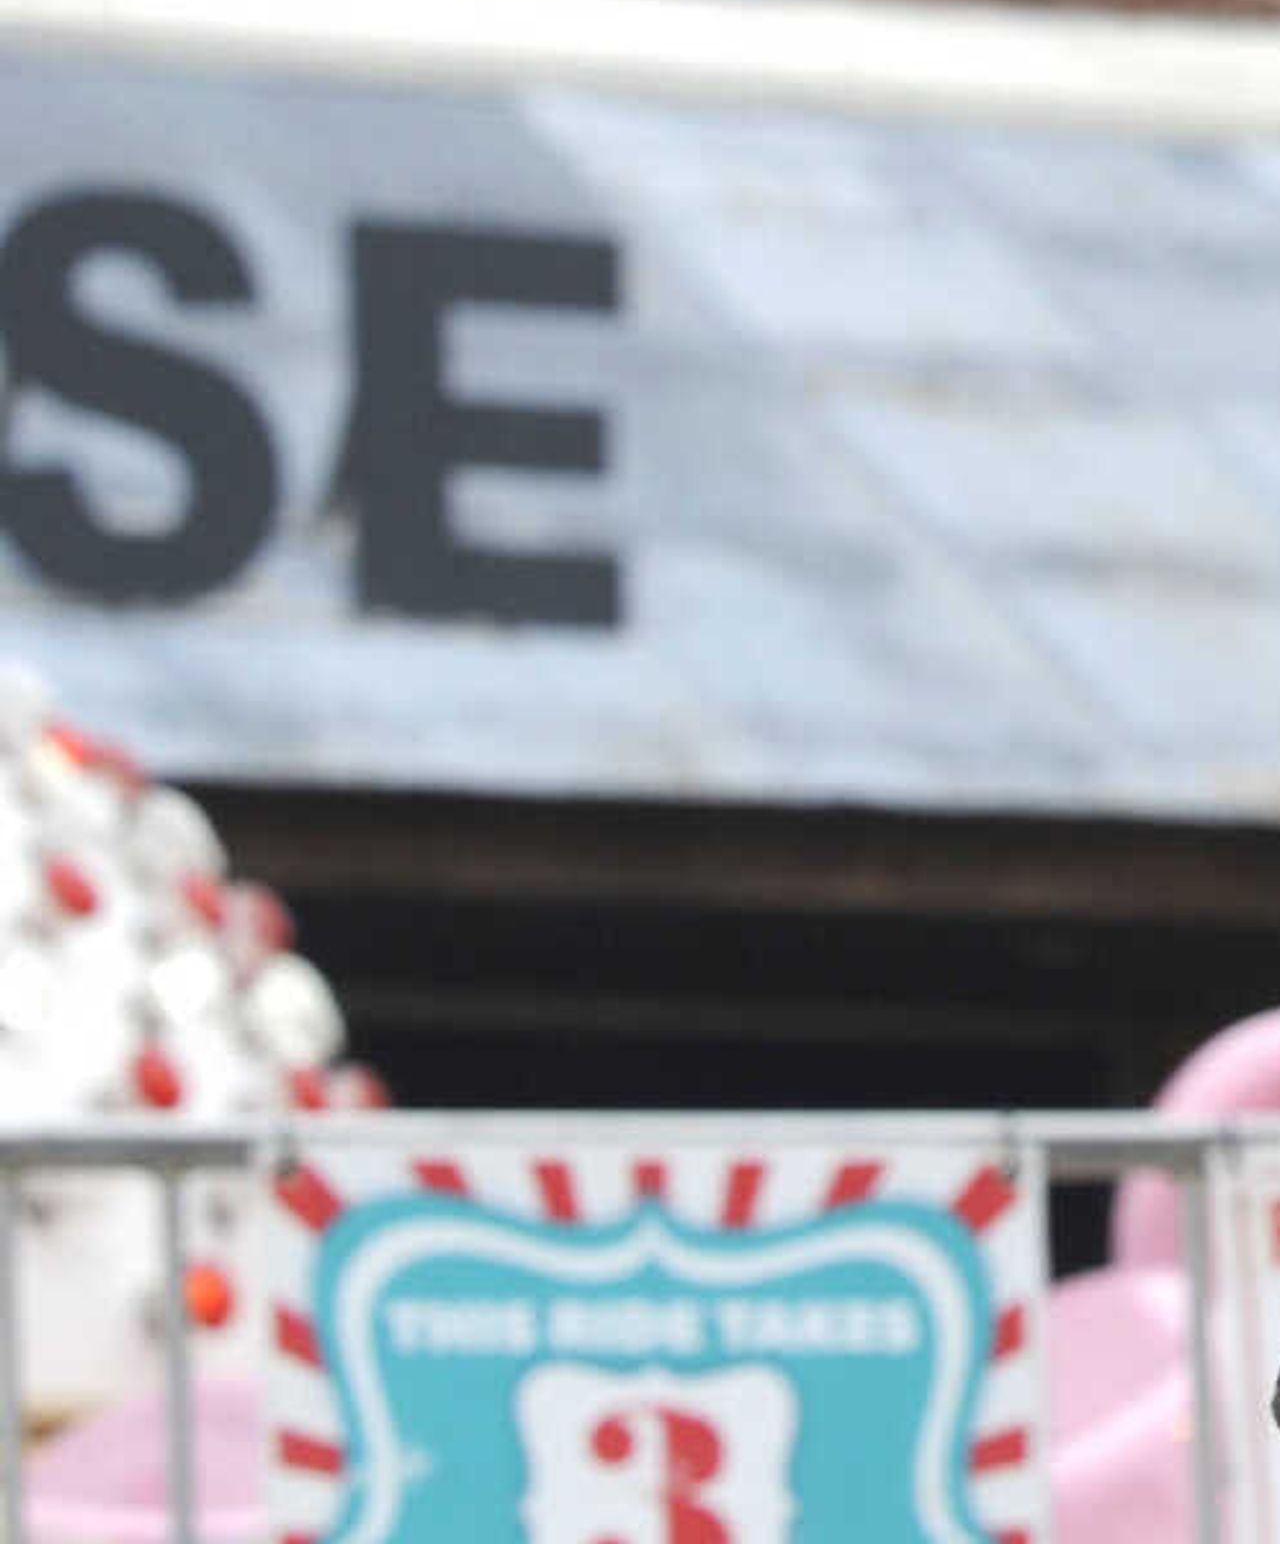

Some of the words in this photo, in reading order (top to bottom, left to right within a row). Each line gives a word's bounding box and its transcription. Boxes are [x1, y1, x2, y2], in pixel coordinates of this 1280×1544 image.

[0, 189, 626, 628] SE
[385, 1297, 538, 1355] THIS
[547, 1297, 704, 1355] RIDE
[712, 1297, 924, 1355] TAKES
[588, 1400, 736, 1544] 3
